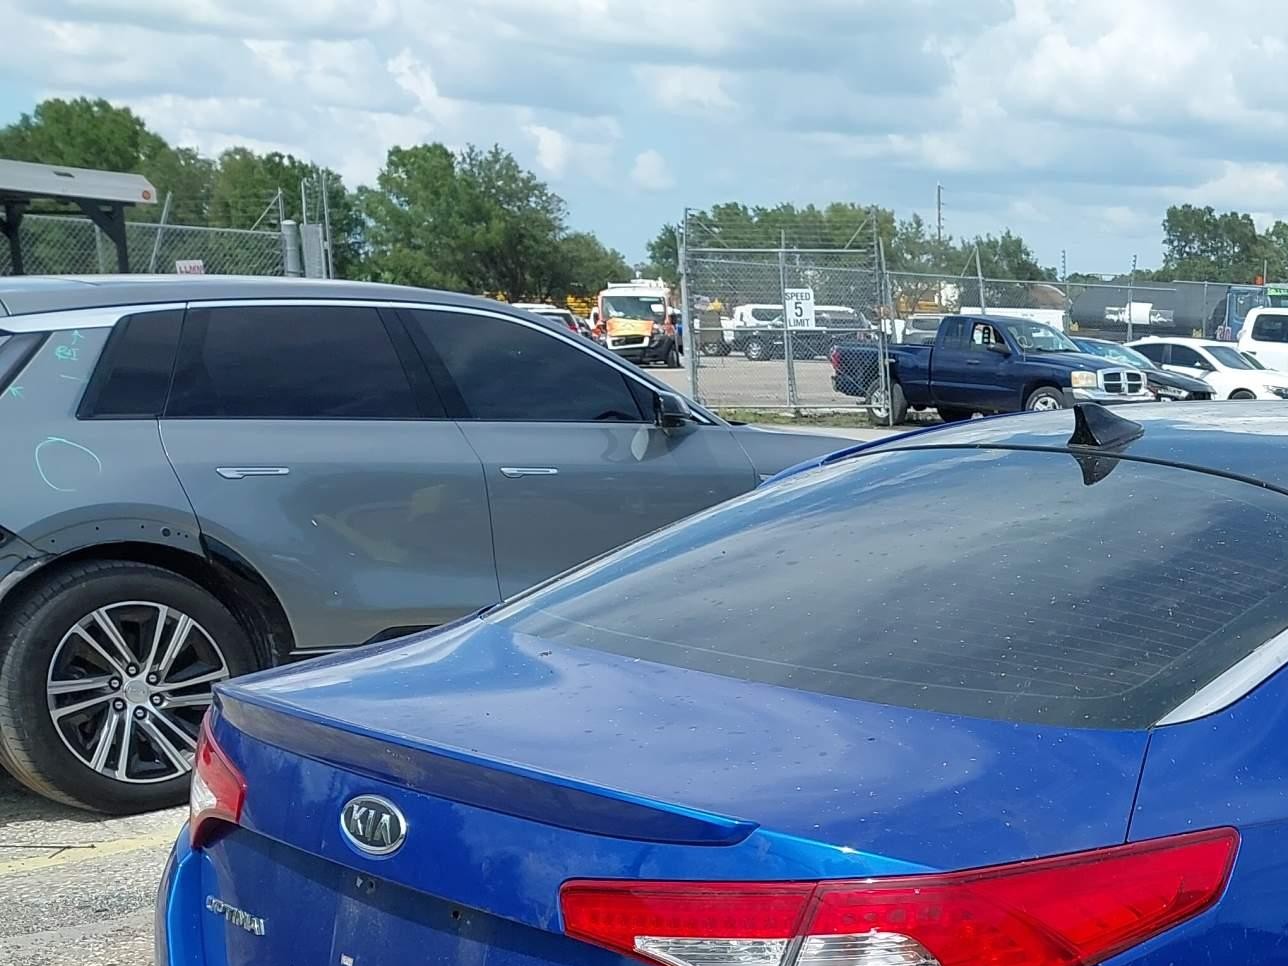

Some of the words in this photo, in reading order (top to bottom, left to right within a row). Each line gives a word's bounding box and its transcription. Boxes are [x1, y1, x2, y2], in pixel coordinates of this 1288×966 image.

[784, 292, 811, 301] SPEED
[795, 302, 804, 318] 5
[788, 318, 811, 328] LIMIT
[350, 804, 391, 846] KIA
[205, 895, 265, 936] OPTIMA
